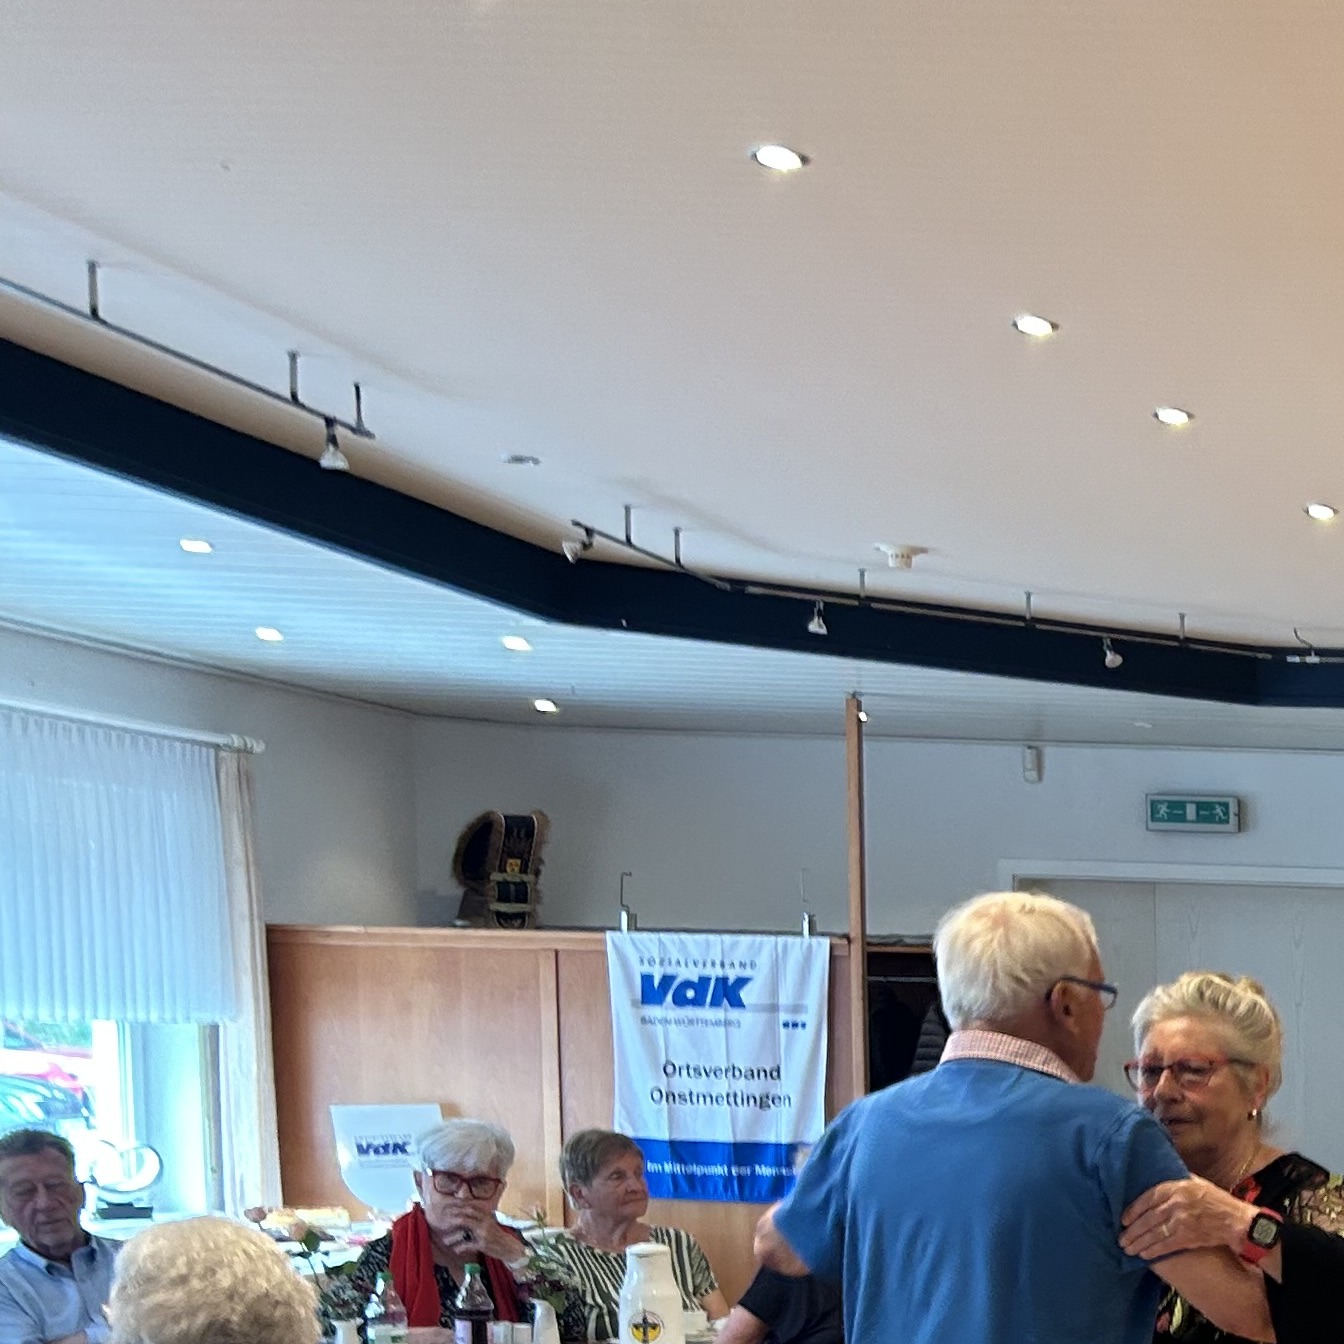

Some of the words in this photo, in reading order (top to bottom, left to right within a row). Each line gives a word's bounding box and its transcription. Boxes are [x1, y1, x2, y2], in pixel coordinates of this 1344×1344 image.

[638, 955, 758, 970] SOZIALVERBAND
[640, 972, 754, 1009] VdK
[662, 1059, 783, 1083] Ortsverband
[649, 1085, 793, 1112] Onstmettingen
[647, 1160, 663, 1173] Im
[664, 1161, 729, 1177] Mittelpunkt
